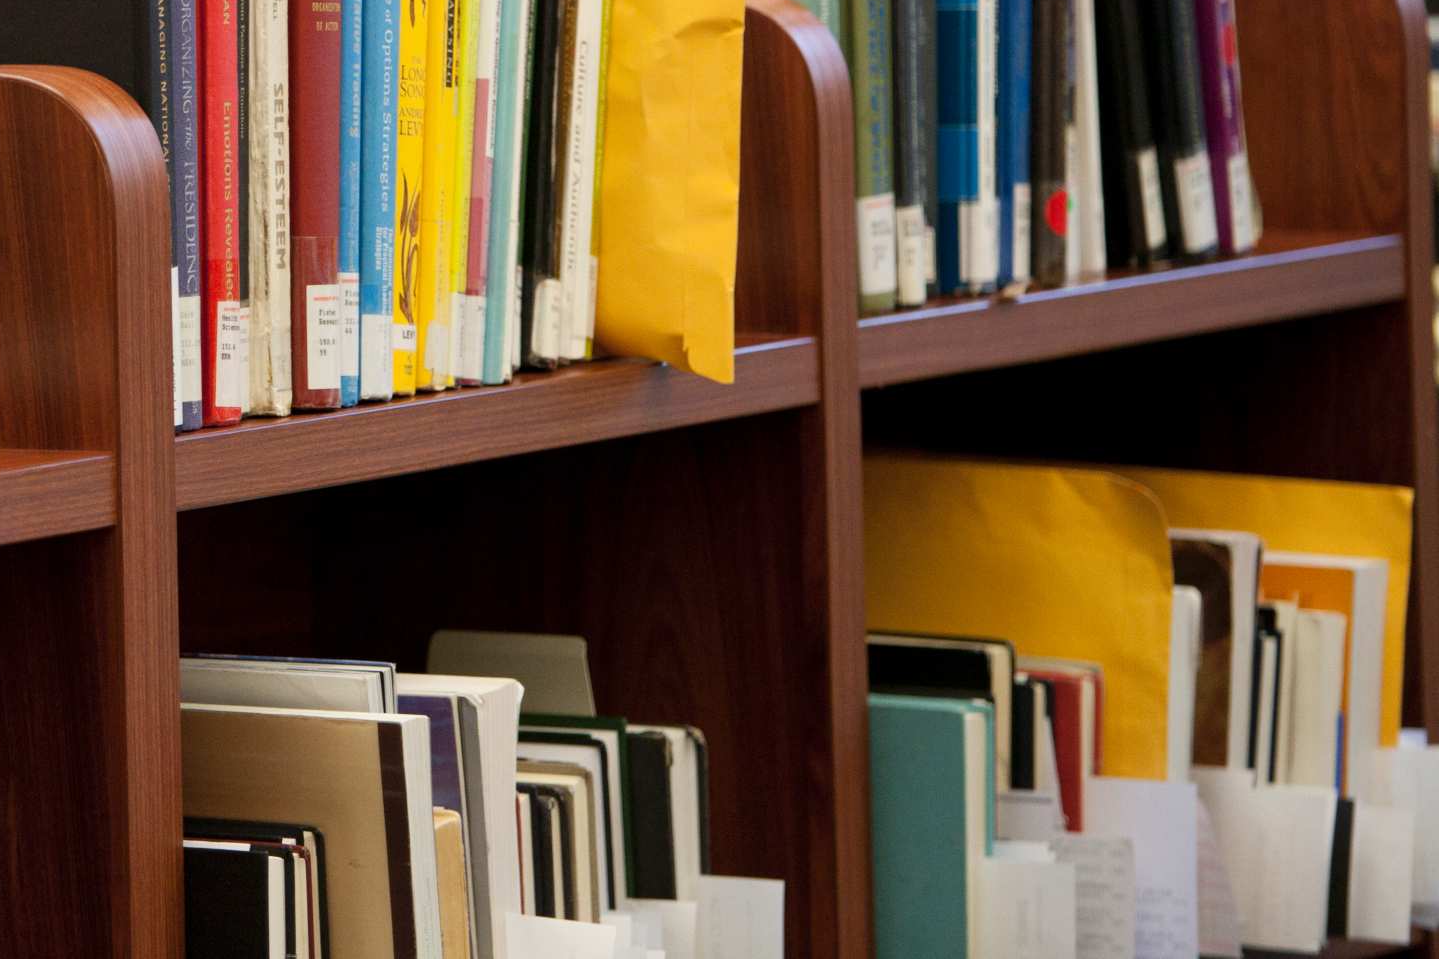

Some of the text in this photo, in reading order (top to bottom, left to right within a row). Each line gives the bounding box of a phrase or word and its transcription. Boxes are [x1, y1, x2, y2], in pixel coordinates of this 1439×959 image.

[349, 62, 362, 138] Trading
[381, 29, 394, 107] Options
[575, 40, 588, 114] Culture
[223, 101, 233, 201] Emotions
[379, 111, 393, 212] Strategies
[399, 120, 424, 136] LEV
[573, 124, 582, 164] and
[273, 82, 286, 270] SELF-ESTEEM
[568, 170, 582, 271] Authentic
[183, 160, 198, 294] PRESIDENC
